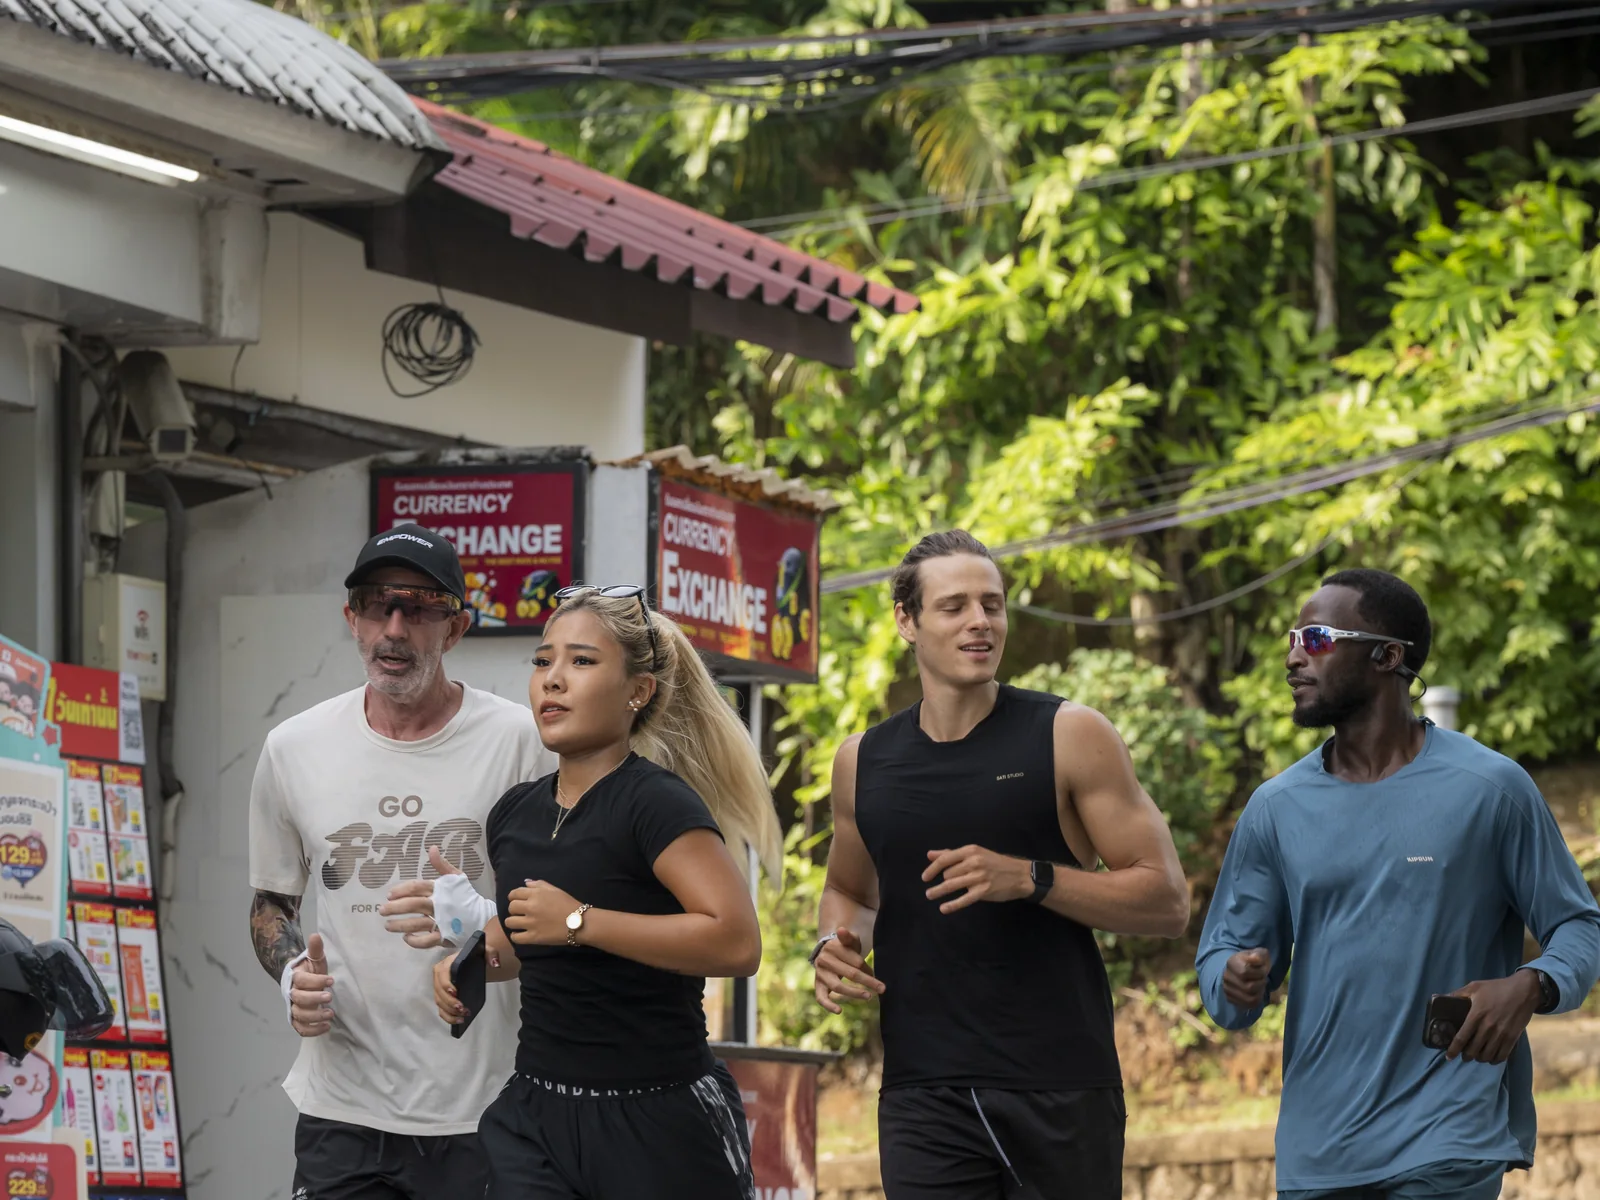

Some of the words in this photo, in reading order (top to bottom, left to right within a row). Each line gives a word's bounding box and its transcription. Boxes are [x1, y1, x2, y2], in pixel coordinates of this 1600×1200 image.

[393, 493, 513, 515] CURRENCY
[376, 533, 434, 549] EMPOWER
[392, 518, 563, 556] CHANGE
[663, 512, 735, 558] CURRENCY
[1007, 771, 1025, 779] STUDIO
[378, 795, 423, 817] GO
[321, 818, 485, 890] FAR
[351, 904, 373, 913] FOR
[8, 1178, 37, 1195] 229
